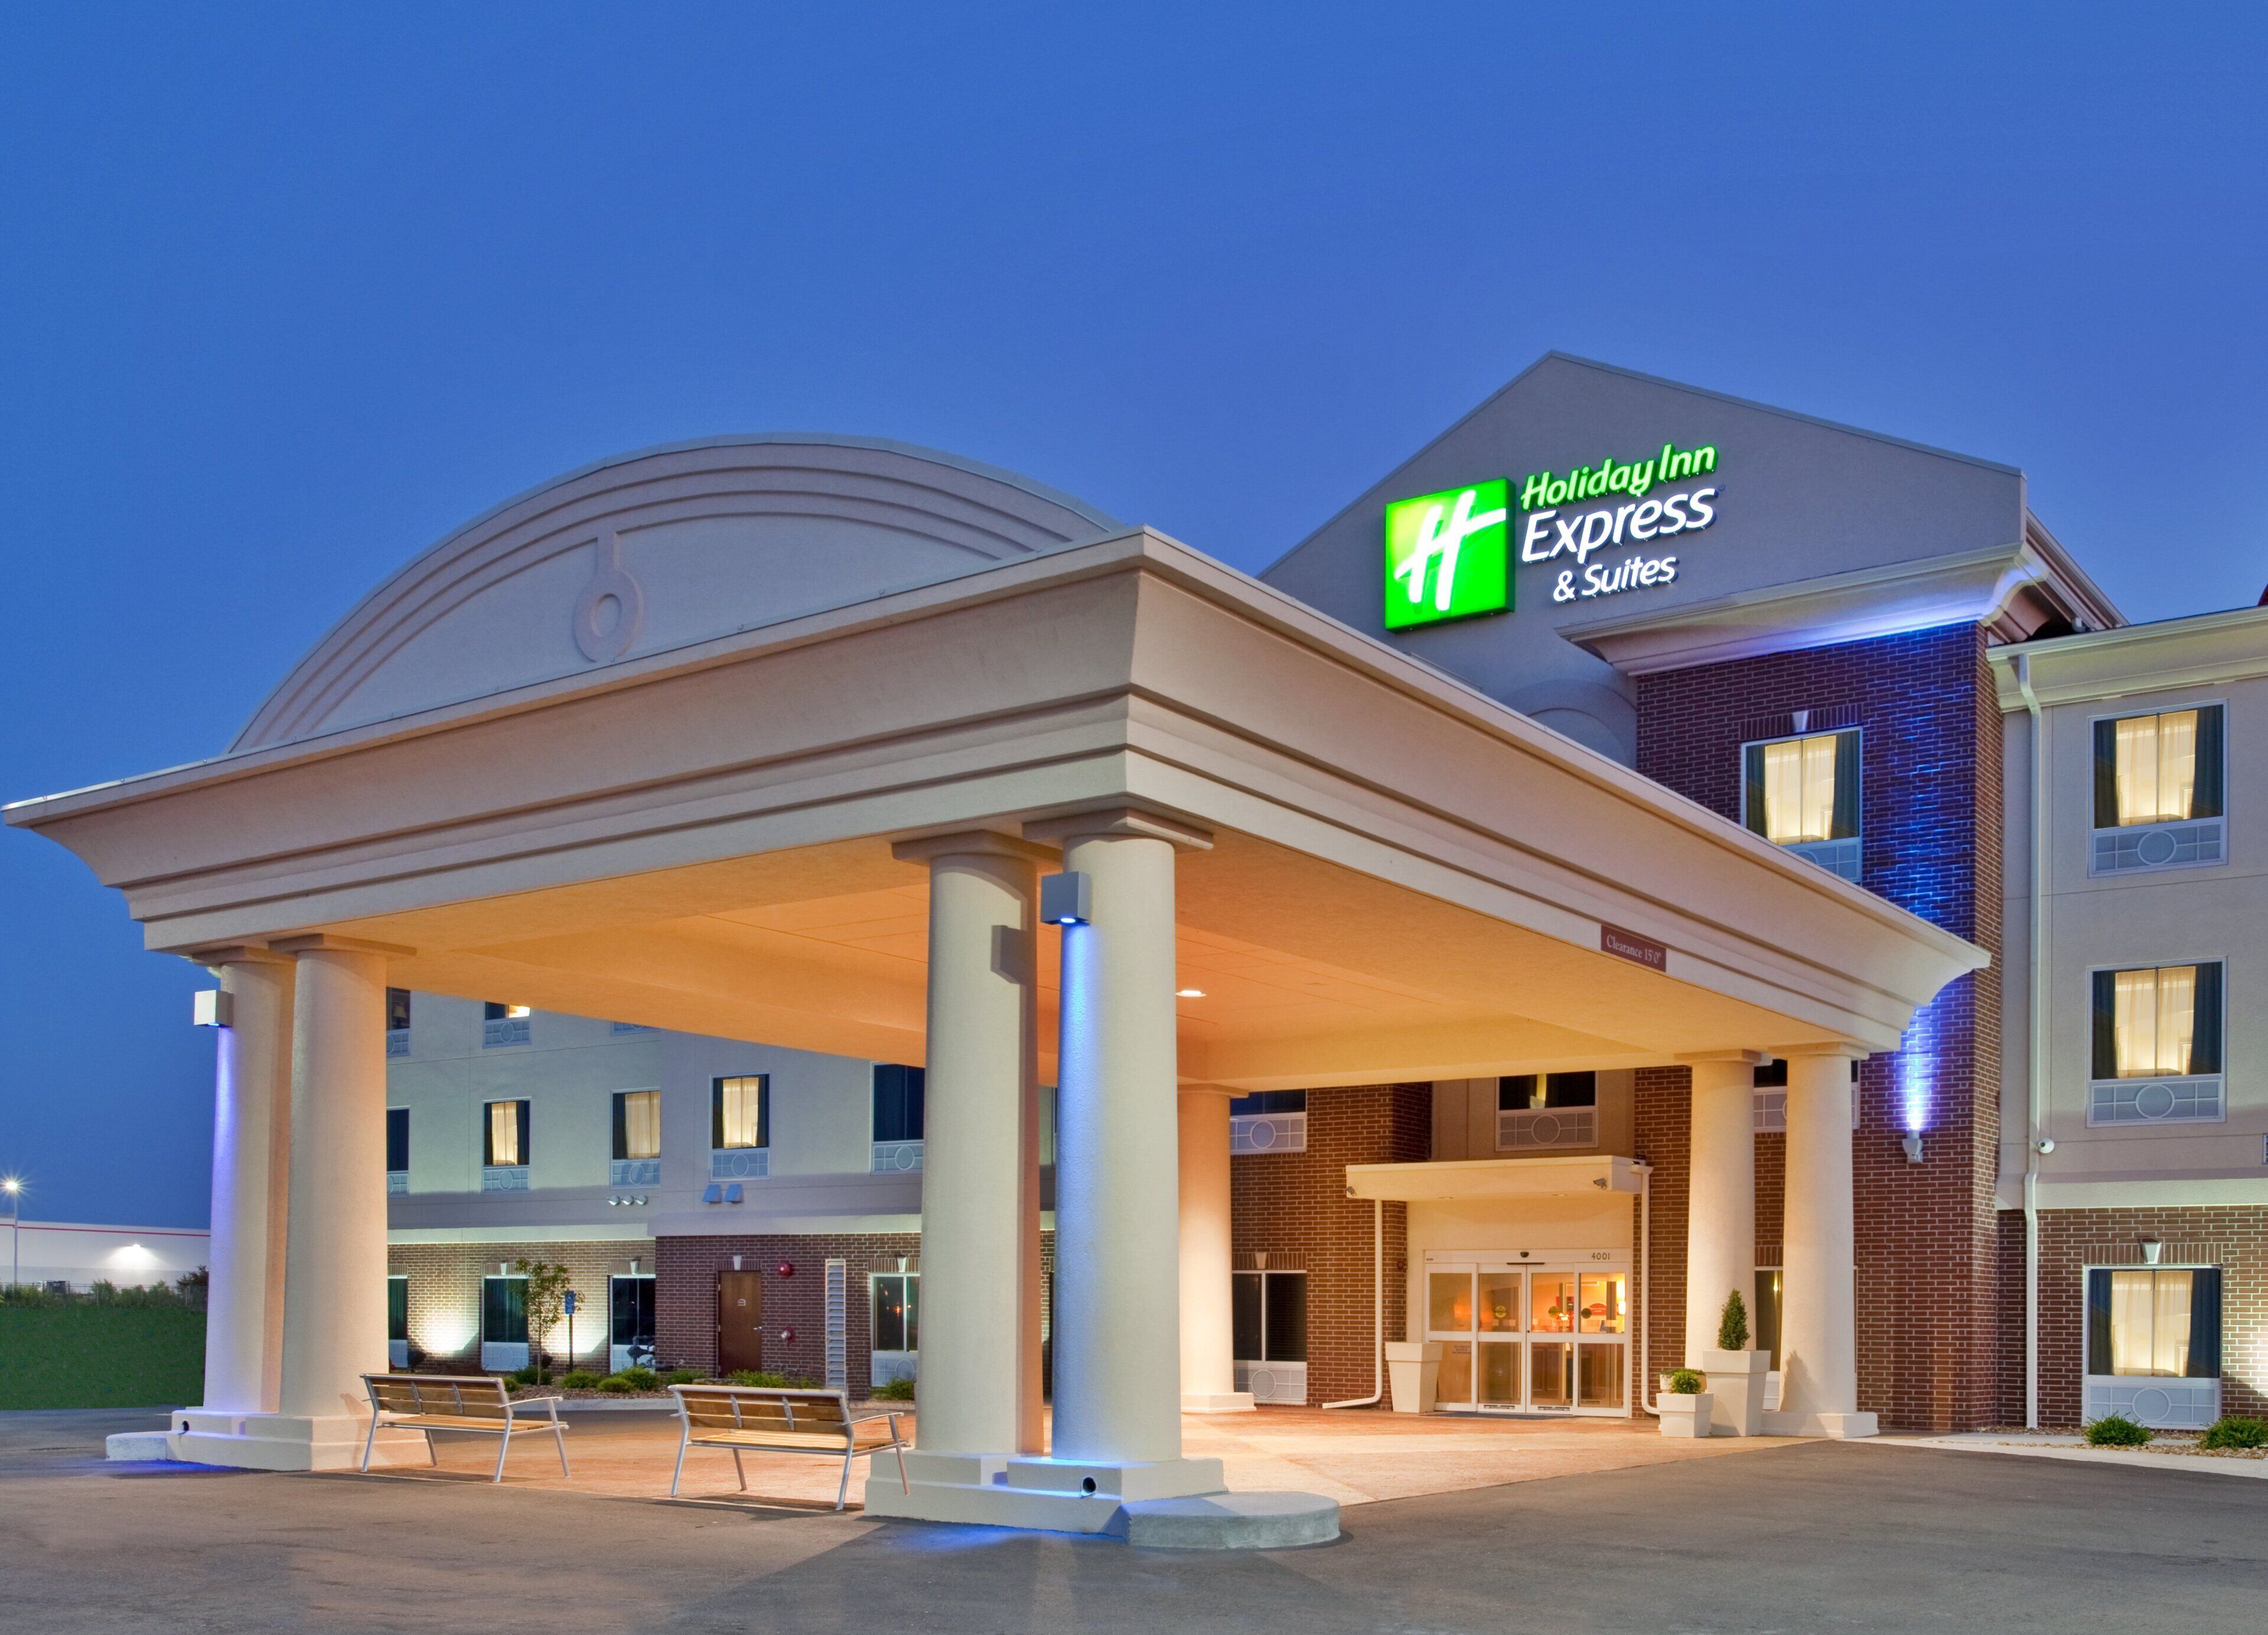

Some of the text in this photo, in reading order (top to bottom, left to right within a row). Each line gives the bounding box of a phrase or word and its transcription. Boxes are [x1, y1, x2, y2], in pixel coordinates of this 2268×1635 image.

[1520, 443, 1717, 511] Holiday Inn
[1521, 488, 1718, 565] Express
[1553, 556, 1678, 602] & Suites
[1606, 934, 1643, 958] Clearance
[1591, 1252, 1610, 1261] 4001
